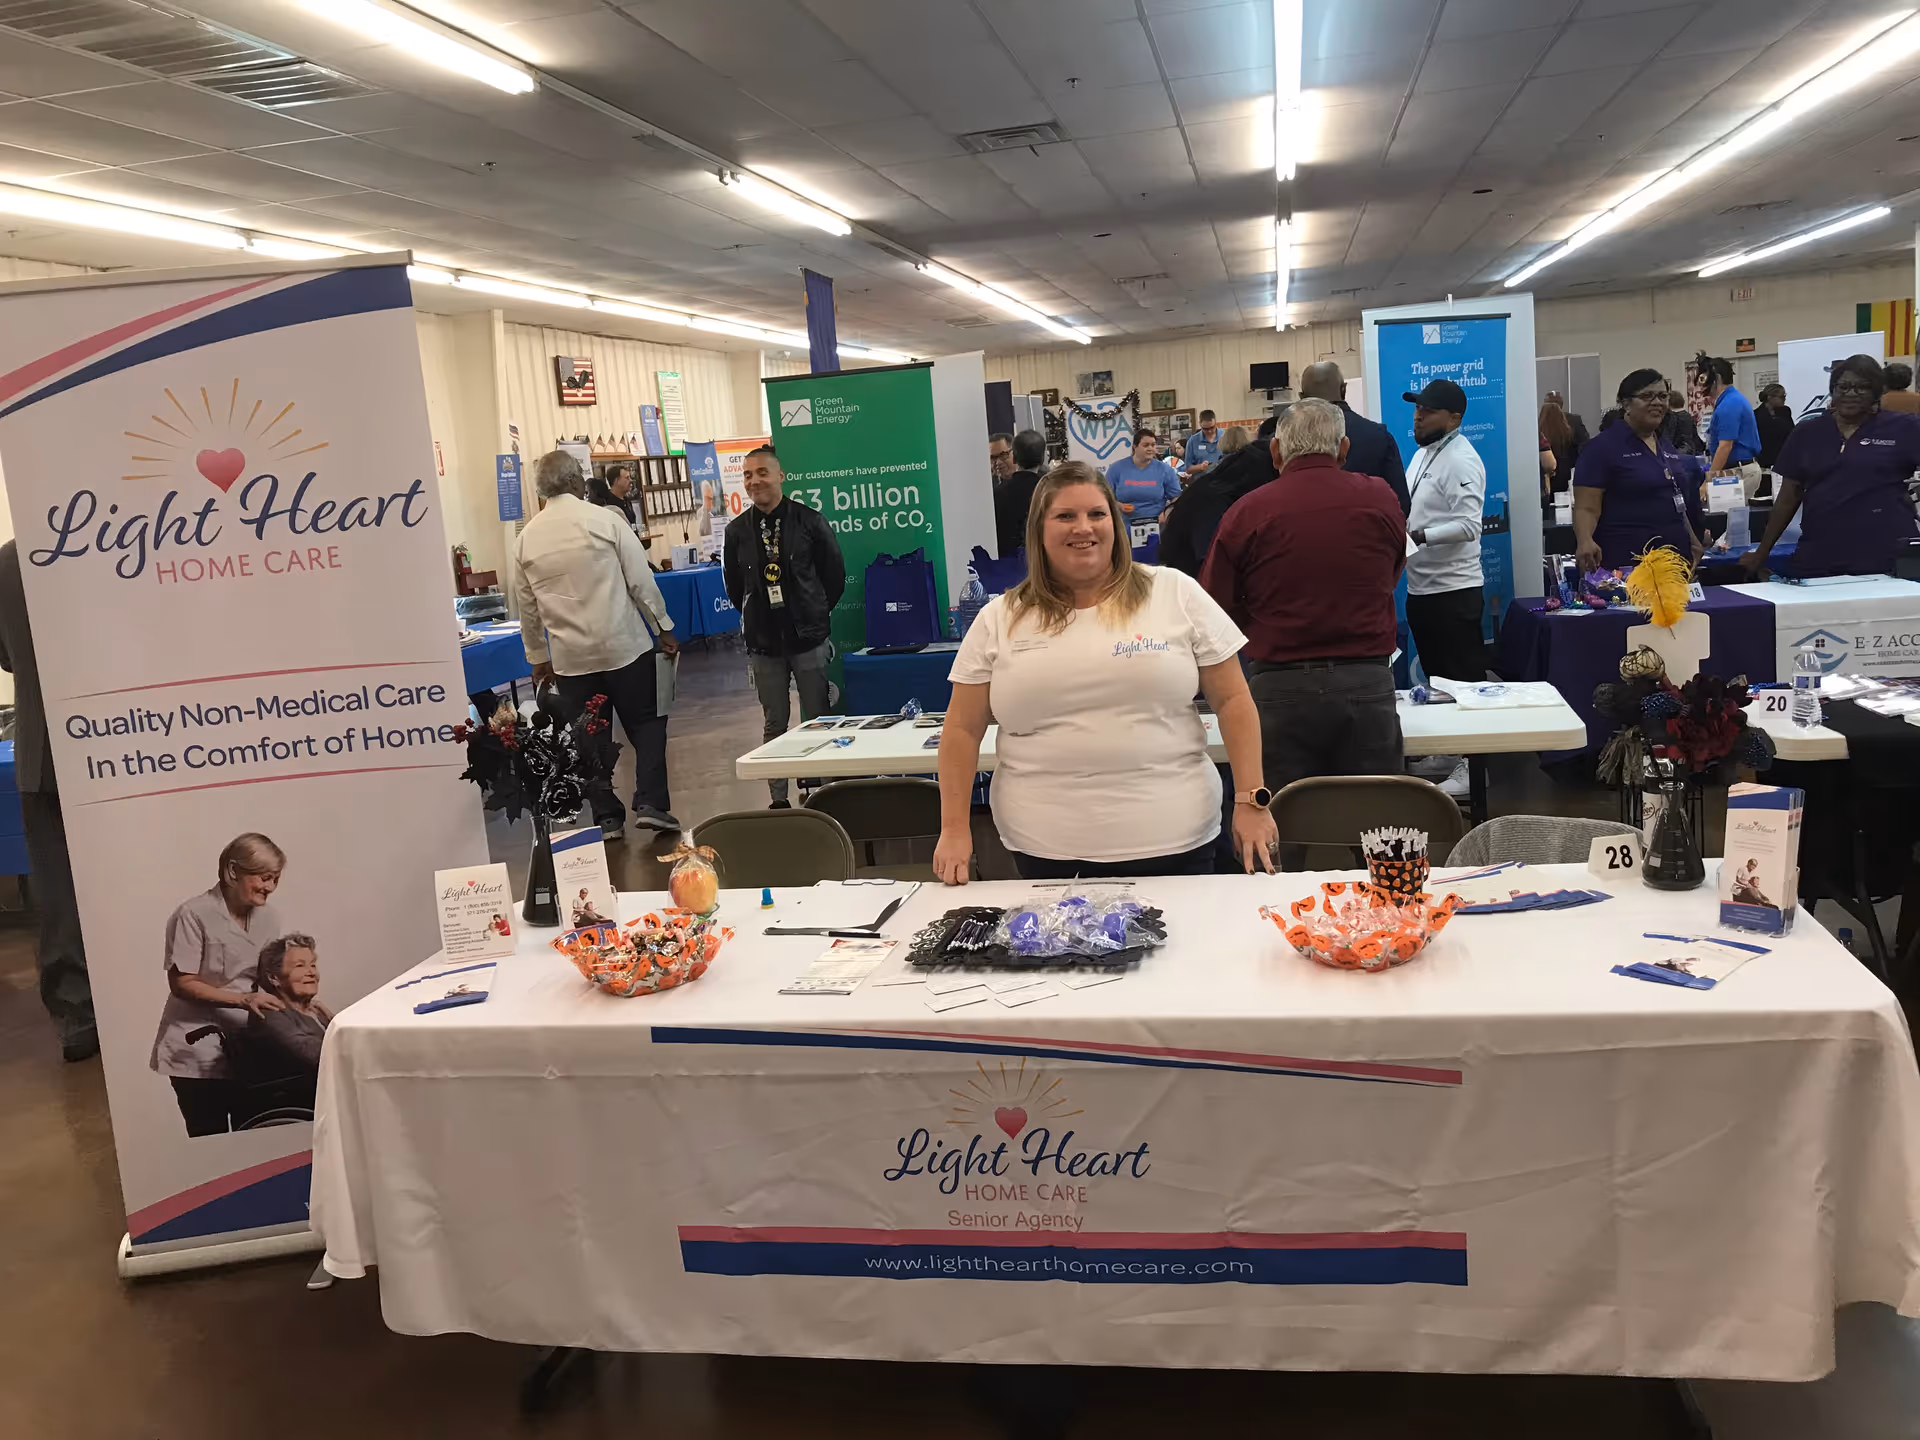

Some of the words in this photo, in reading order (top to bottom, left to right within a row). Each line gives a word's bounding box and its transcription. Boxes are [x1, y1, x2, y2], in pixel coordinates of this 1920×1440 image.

[1441, 337, 1464, 345] Energy
[1411, 361, 1429, 375] The
[1430, 363, 1461, 377] power
[1462, 358, 1484, 375] grid
[1410, 379, 1418, 391] is
[814, 397, 843, 406] Green
[815, 404, 860, 415] Mountain
[816, 415, 850, 424] Energy
[1077, 414, 1134, 440] WPA
[728, 455, 742, 464] GET
[786, 472, 803, 481] Our
[805, 468, 854, 480] customers
[855, 466, 878, 476] have
[880, 460, 927, 475] prevented
[832, 482, 920, 511] billion
[28, 489, 223, 580] Light
[238, 471, 429, 541] Heart
[828, 515, 863, 533] nds
[869, 511, 888, 531] of
[155, 553, 255, 585] HOME
[264, 545, 343, 577] CARE
[1690, 587, 1701, 598] 18
[1111, 640, 1142, 659] Light
[1142, 637, 1170, 651] Heart
[1854, 635, 1883, 649] E-Z
[65, 707, 174, 739] Quality
[180, 685, 370, 729] Non-Medical
[374, 683, 446, 709] Care
[1765, 695, 1787, 712] 20
[86, 755, 117, 780] In
[121, 750, 177, 776] the
[183, 734, 319, 769] Comfort
[323, 727, 356, 755] of
[362, 723, 457, 751] Home
[1605, 844, 1634, 870] 28
[441, 887, 471, 901] Light
[472, 883, 503, 895] Heart
[883, 1127, 1010, 1195] Light
[1021, 1127, 1151, 1179] Heart
[964, 1183, 1029, 1202] HOME
[1036, 1183, 1088, 1203] CARE
[947, 1209, 1009, 1228] Senior
[1014, 1210, 1084, 1233] Agency
[863, 1253, 1254, 1276] www.lighthearthomecare.com
